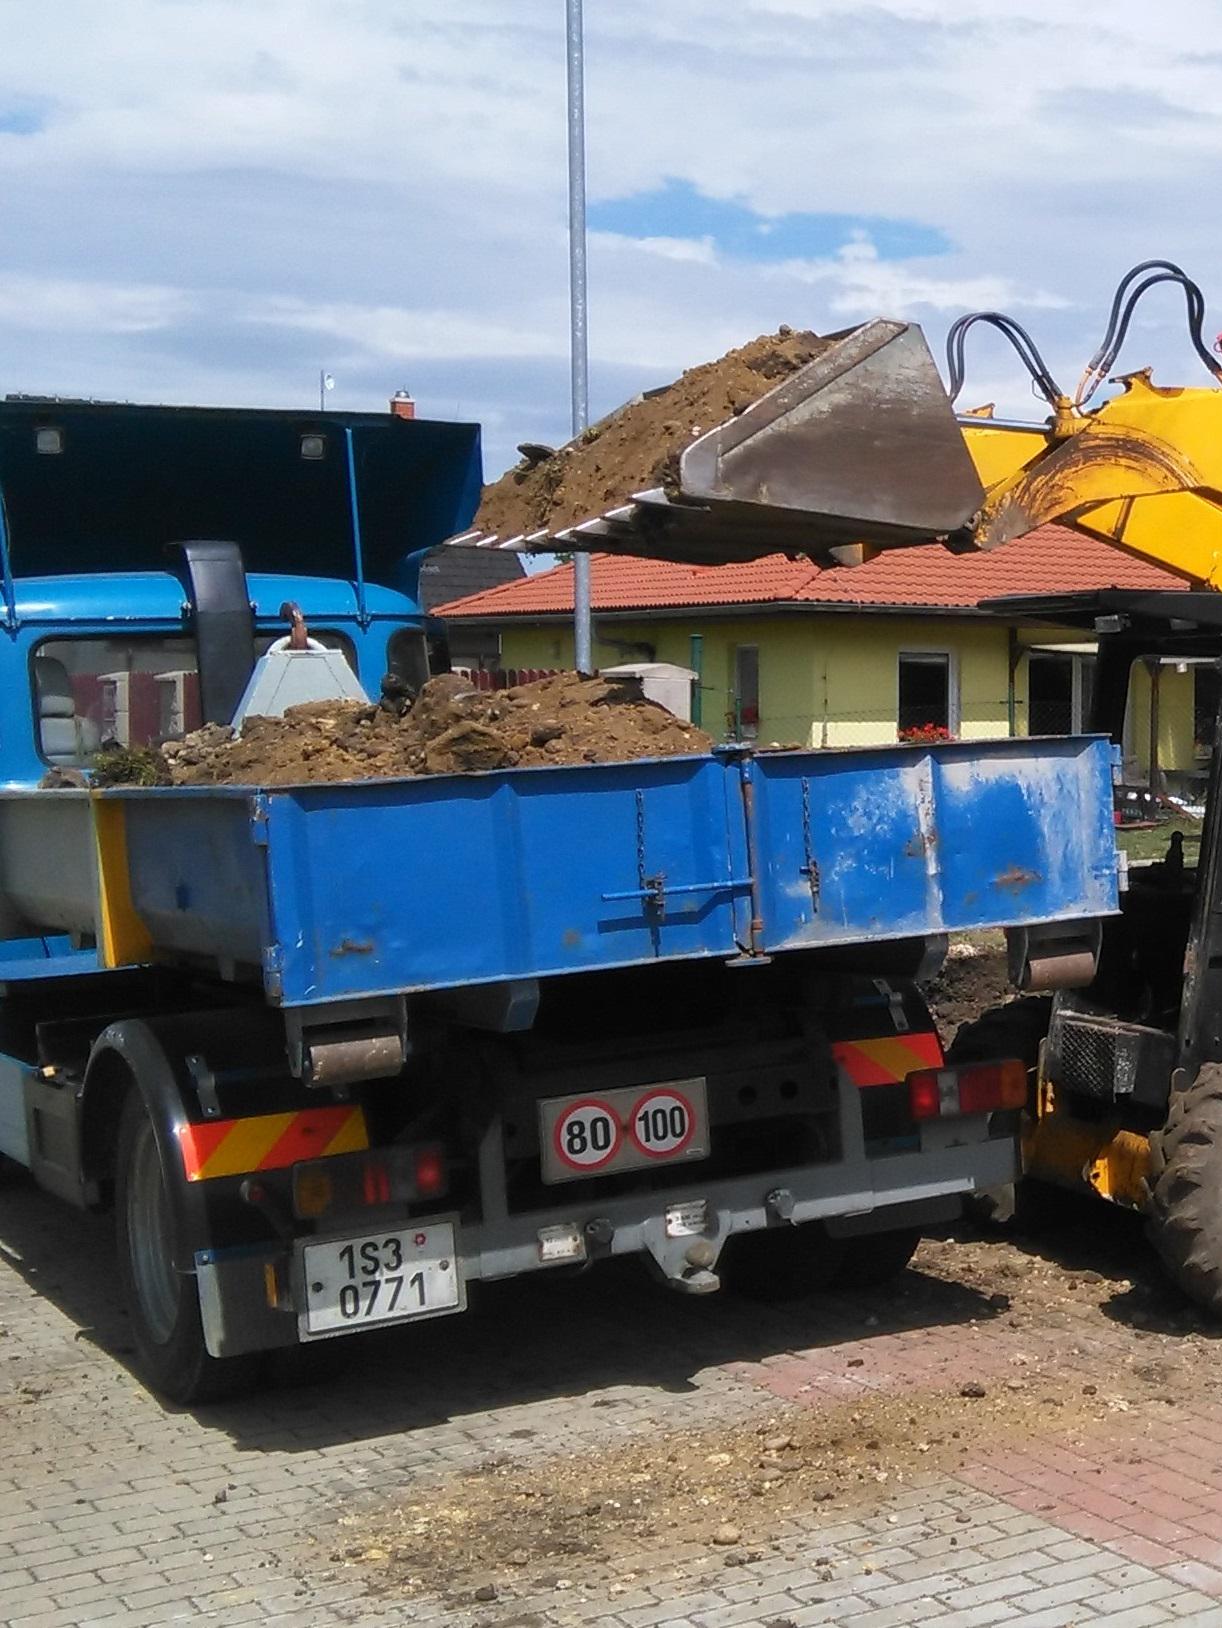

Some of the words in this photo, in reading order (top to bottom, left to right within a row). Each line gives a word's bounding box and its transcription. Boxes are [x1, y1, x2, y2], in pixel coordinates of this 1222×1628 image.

[566, 1116, 611, 1155] 80
[638, 1105, 686, 1143] 100
[339, 1238, 403, 1279] 1S3
[339, 1272, 426, 1319] 0771
